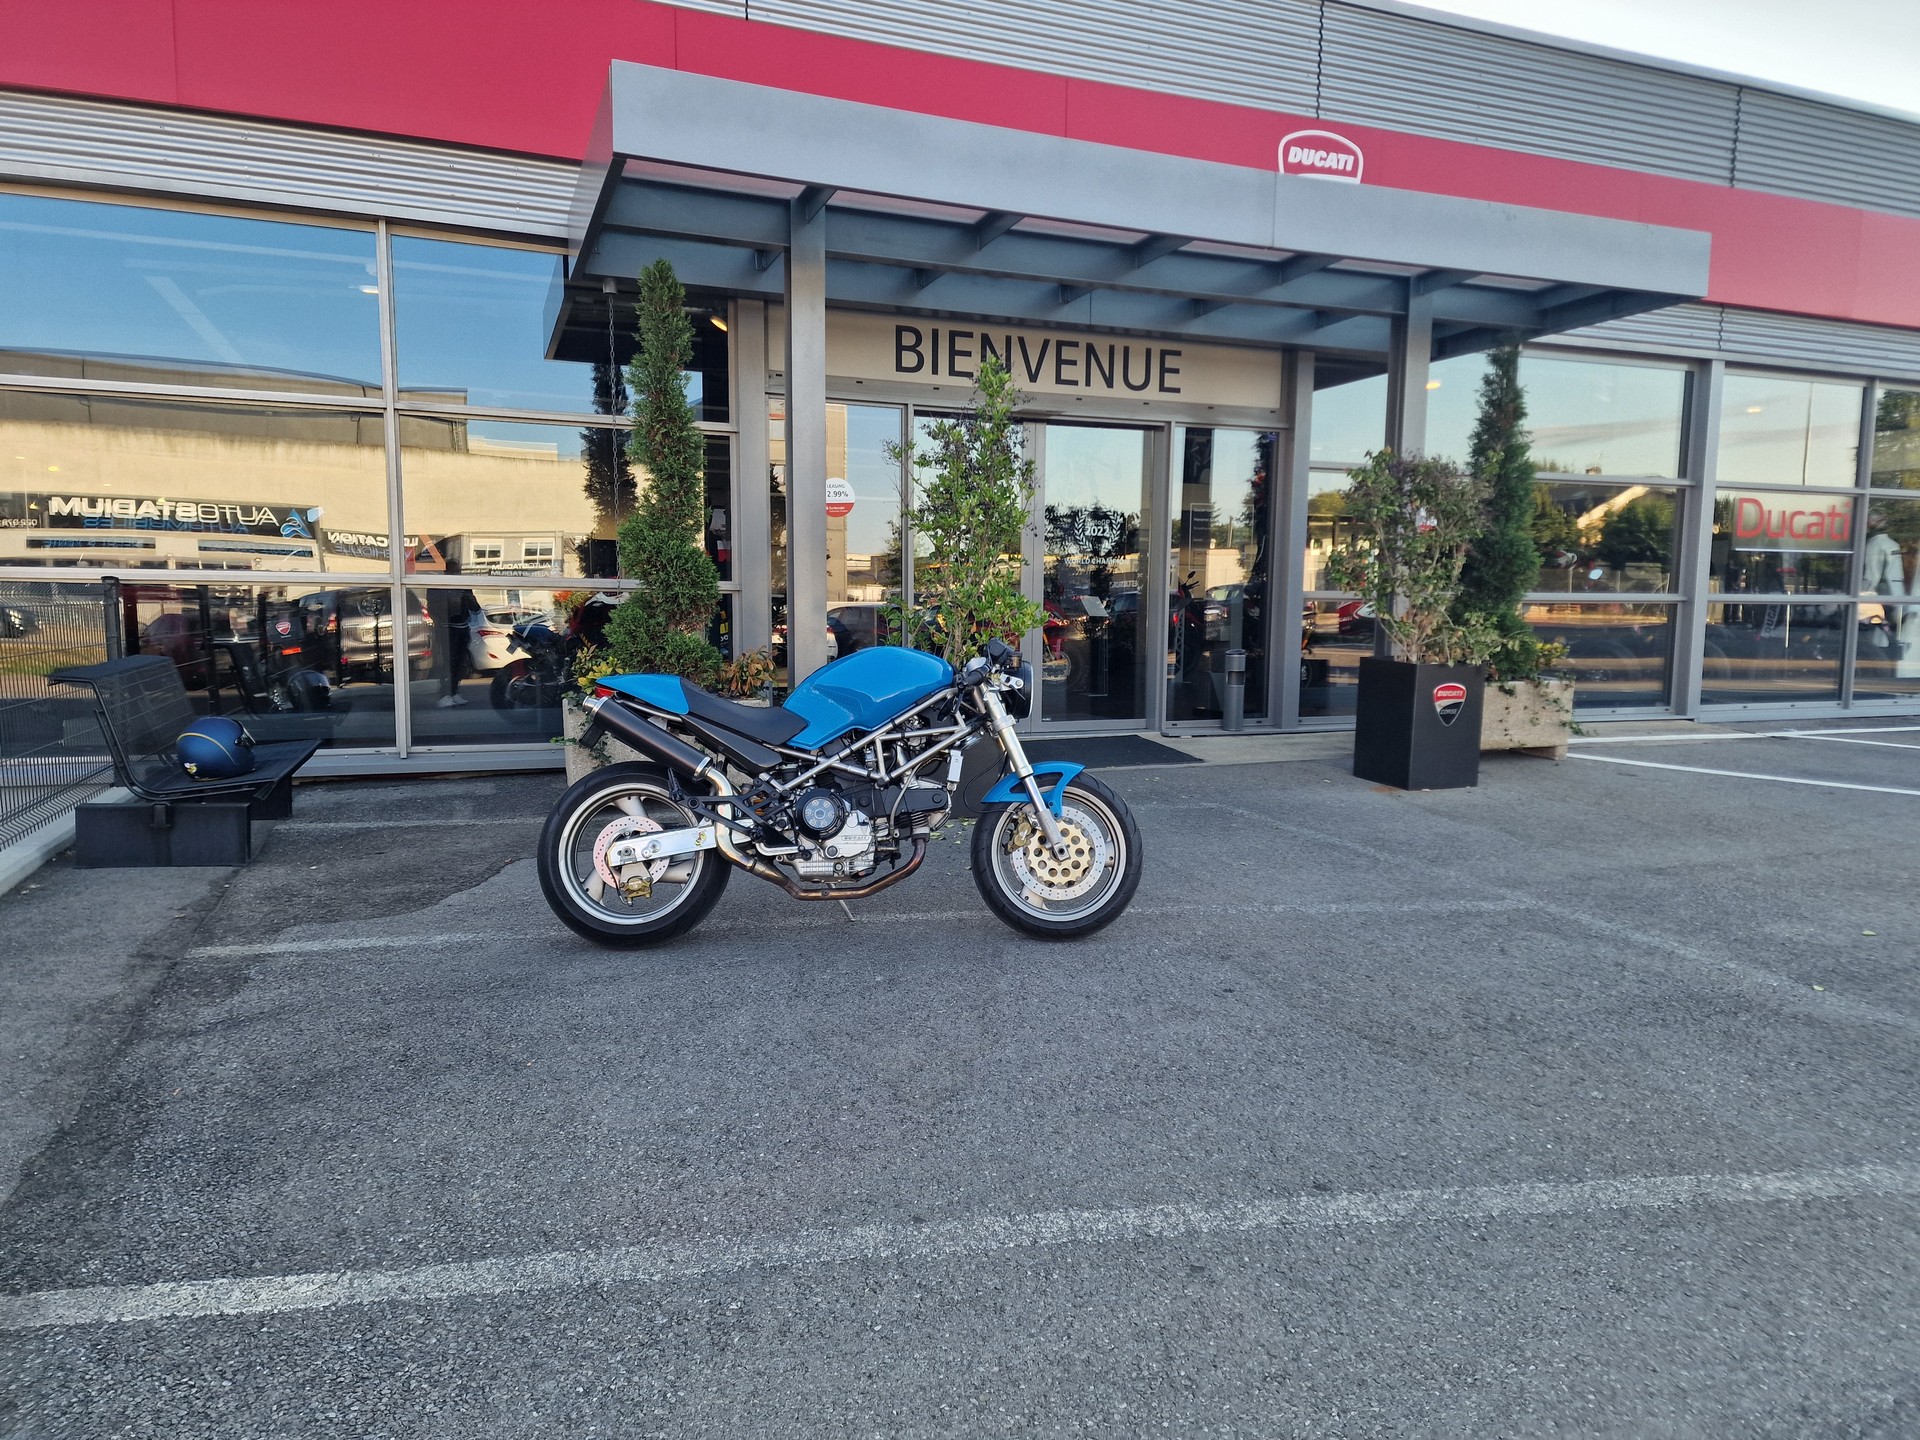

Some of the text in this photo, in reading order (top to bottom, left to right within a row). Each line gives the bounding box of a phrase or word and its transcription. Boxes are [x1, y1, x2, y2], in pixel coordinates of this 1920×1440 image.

[1288, 146, 1355, 171] DUCATI
[895, 324, 1182, 393] BIENVENUE
[1084, 526, 1111, 537] 2022
[1736, 497, 1854, 541] Ducati
